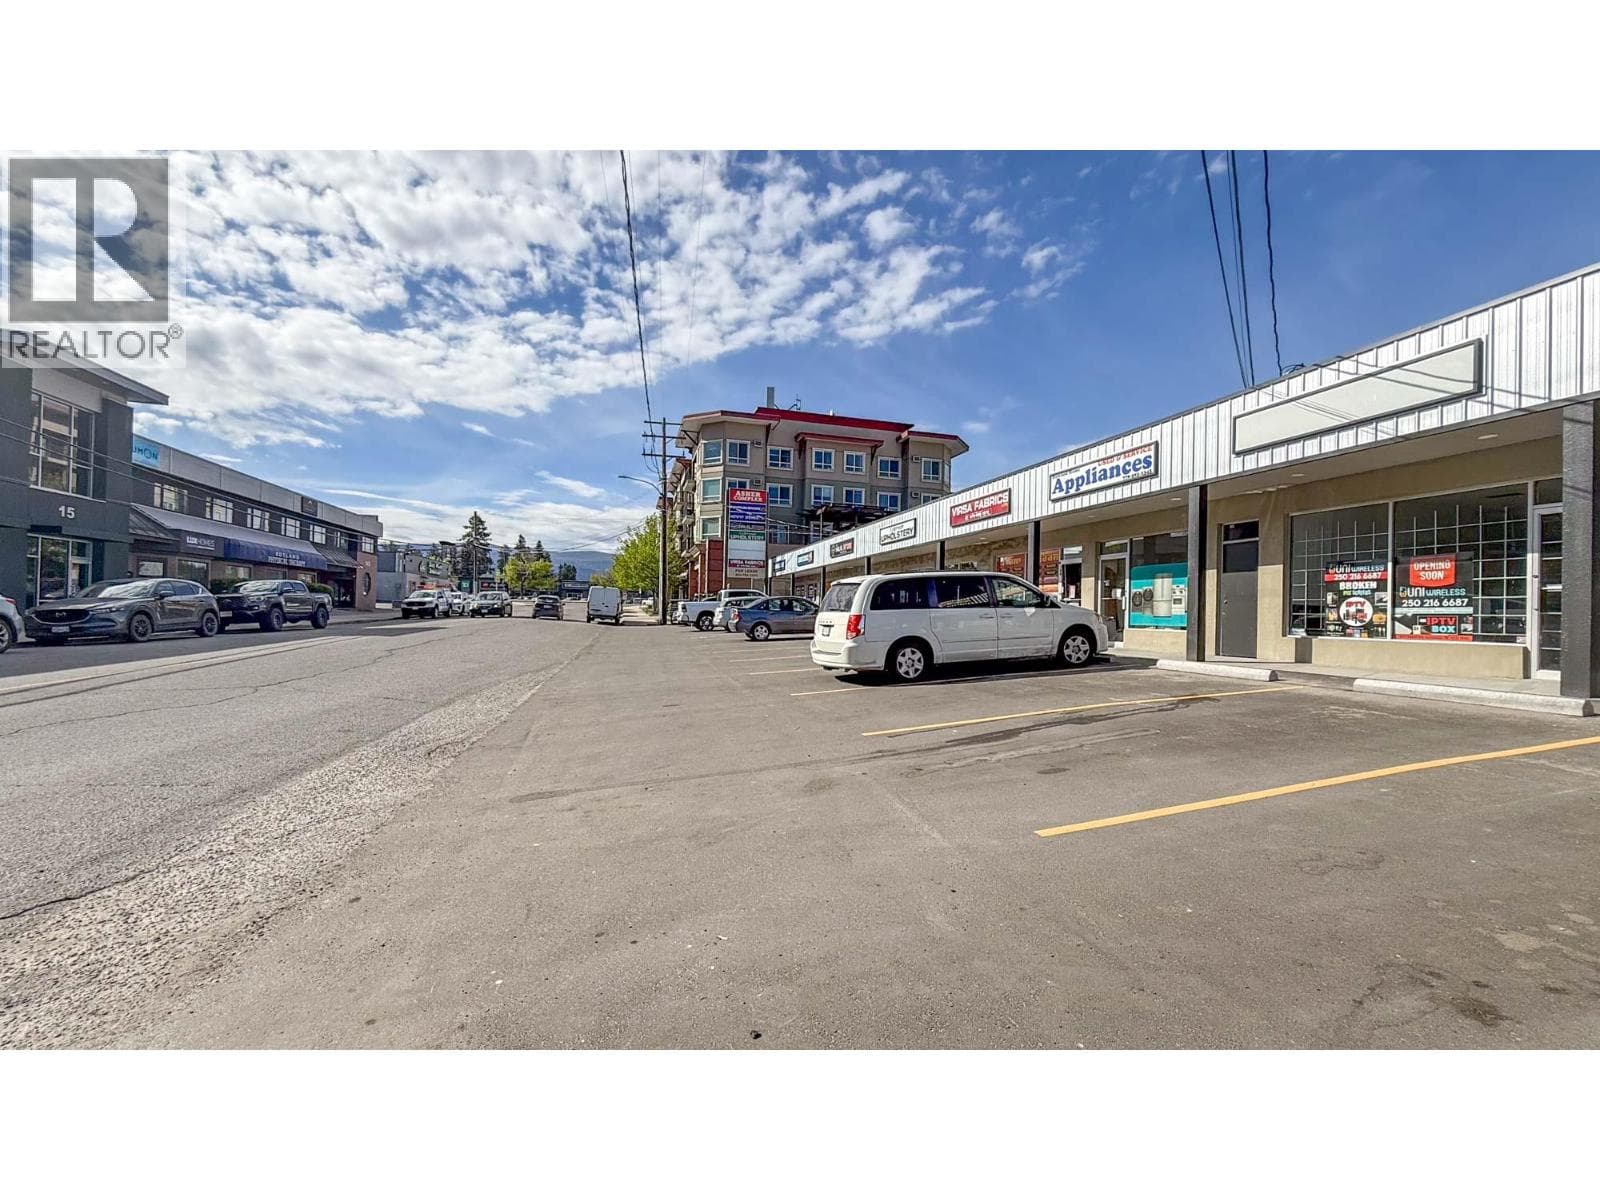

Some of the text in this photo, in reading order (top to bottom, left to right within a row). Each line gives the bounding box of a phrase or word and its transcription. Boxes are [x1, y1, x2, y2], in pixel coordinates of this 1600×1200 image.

[1123, 445, 1153, 459] SERVICE
[1052, 455, 1152, 494] Appliances
[735, 490, 761, 499] ASHER
[951, 502, 973, 517] VIRSA
[973, 492, 1009, 512] FABRICS
[58, 505, 75, 519] 15
[1351, 565, 1385, 573] WIRELESS
[1413, 560, 1451, 571] OPENING
[1334, 572, 1382, 581] 250 216 6687
[1419, 570, 1445, 580] SOON
[1339, 581, 1377, 590] BROKEN
[1407, 587, 1466, 597] UNI WIRELESS
[1401, 598, 1469, 607] 250 216 6687
[1426, 617, 1456, 625] IPTV
[1431, 625, 1456, 633] BOX
